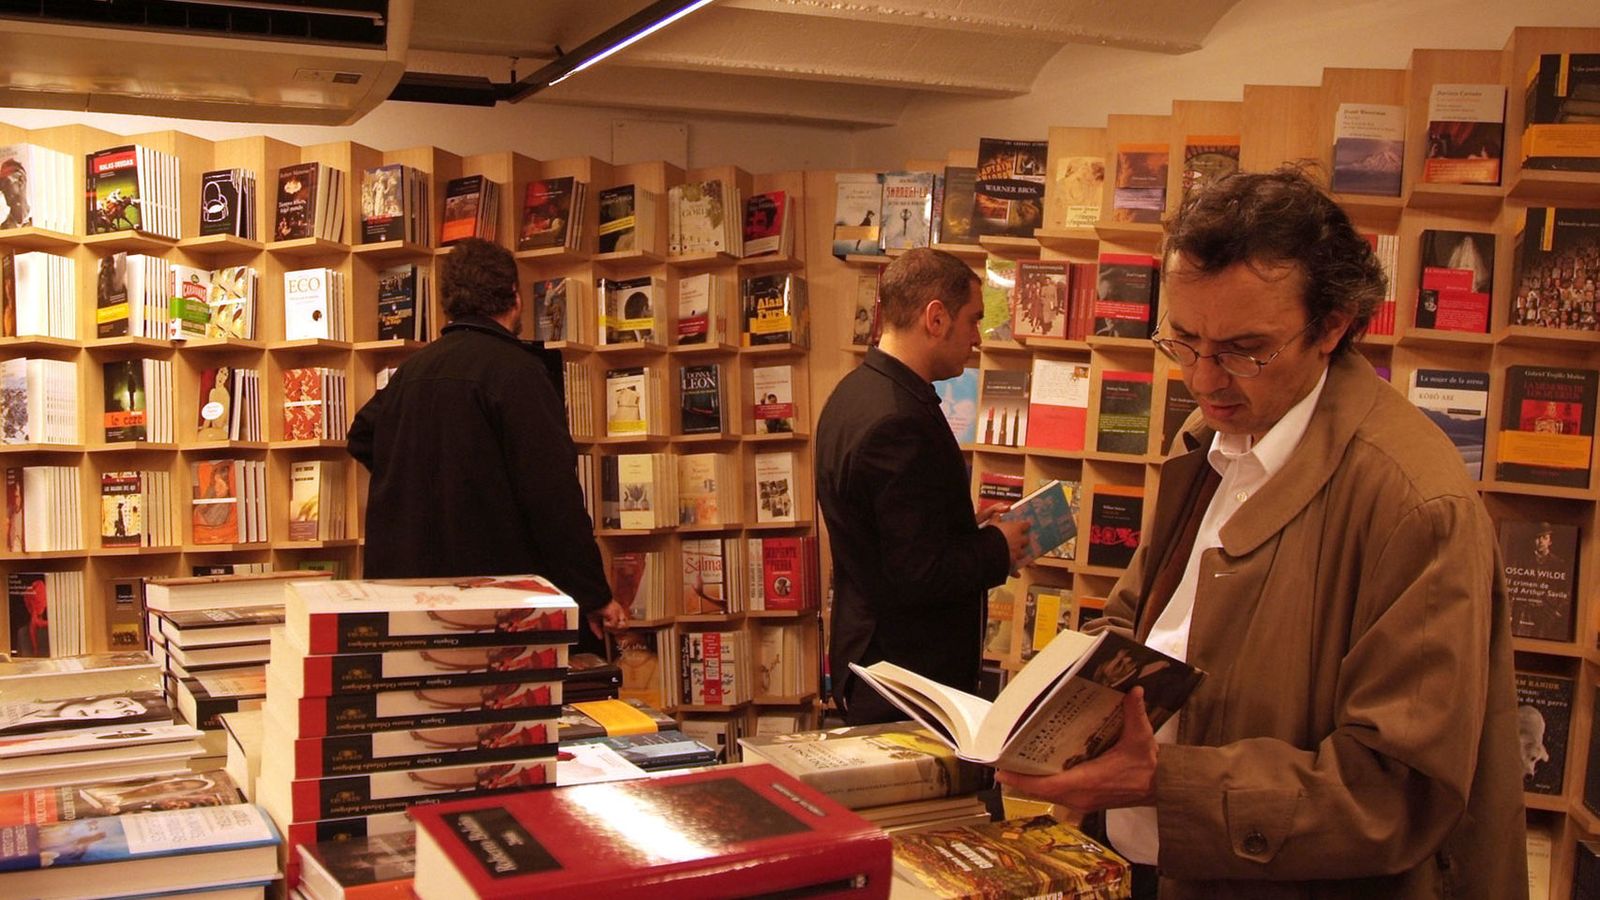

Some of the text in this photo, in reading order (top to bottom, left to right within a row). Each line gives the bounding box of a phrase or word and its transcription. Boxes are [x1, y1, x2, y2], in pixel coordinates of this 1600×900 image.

[985, 184, 1017, 193] WARNER
[288, 277, 321, 294] ECO
[757, 297, 783, 308] Alan
[686, 371, 711, 380] DONNA
[1524, 370, 1545, 378] Gabriel
[682, 376, 717, 390] LEON
[685, 555, 722, 574] Salma
[1505, 567, 1566, 581] OSCAR WILDE
[1520, 588, 1546, 596] Arthur
